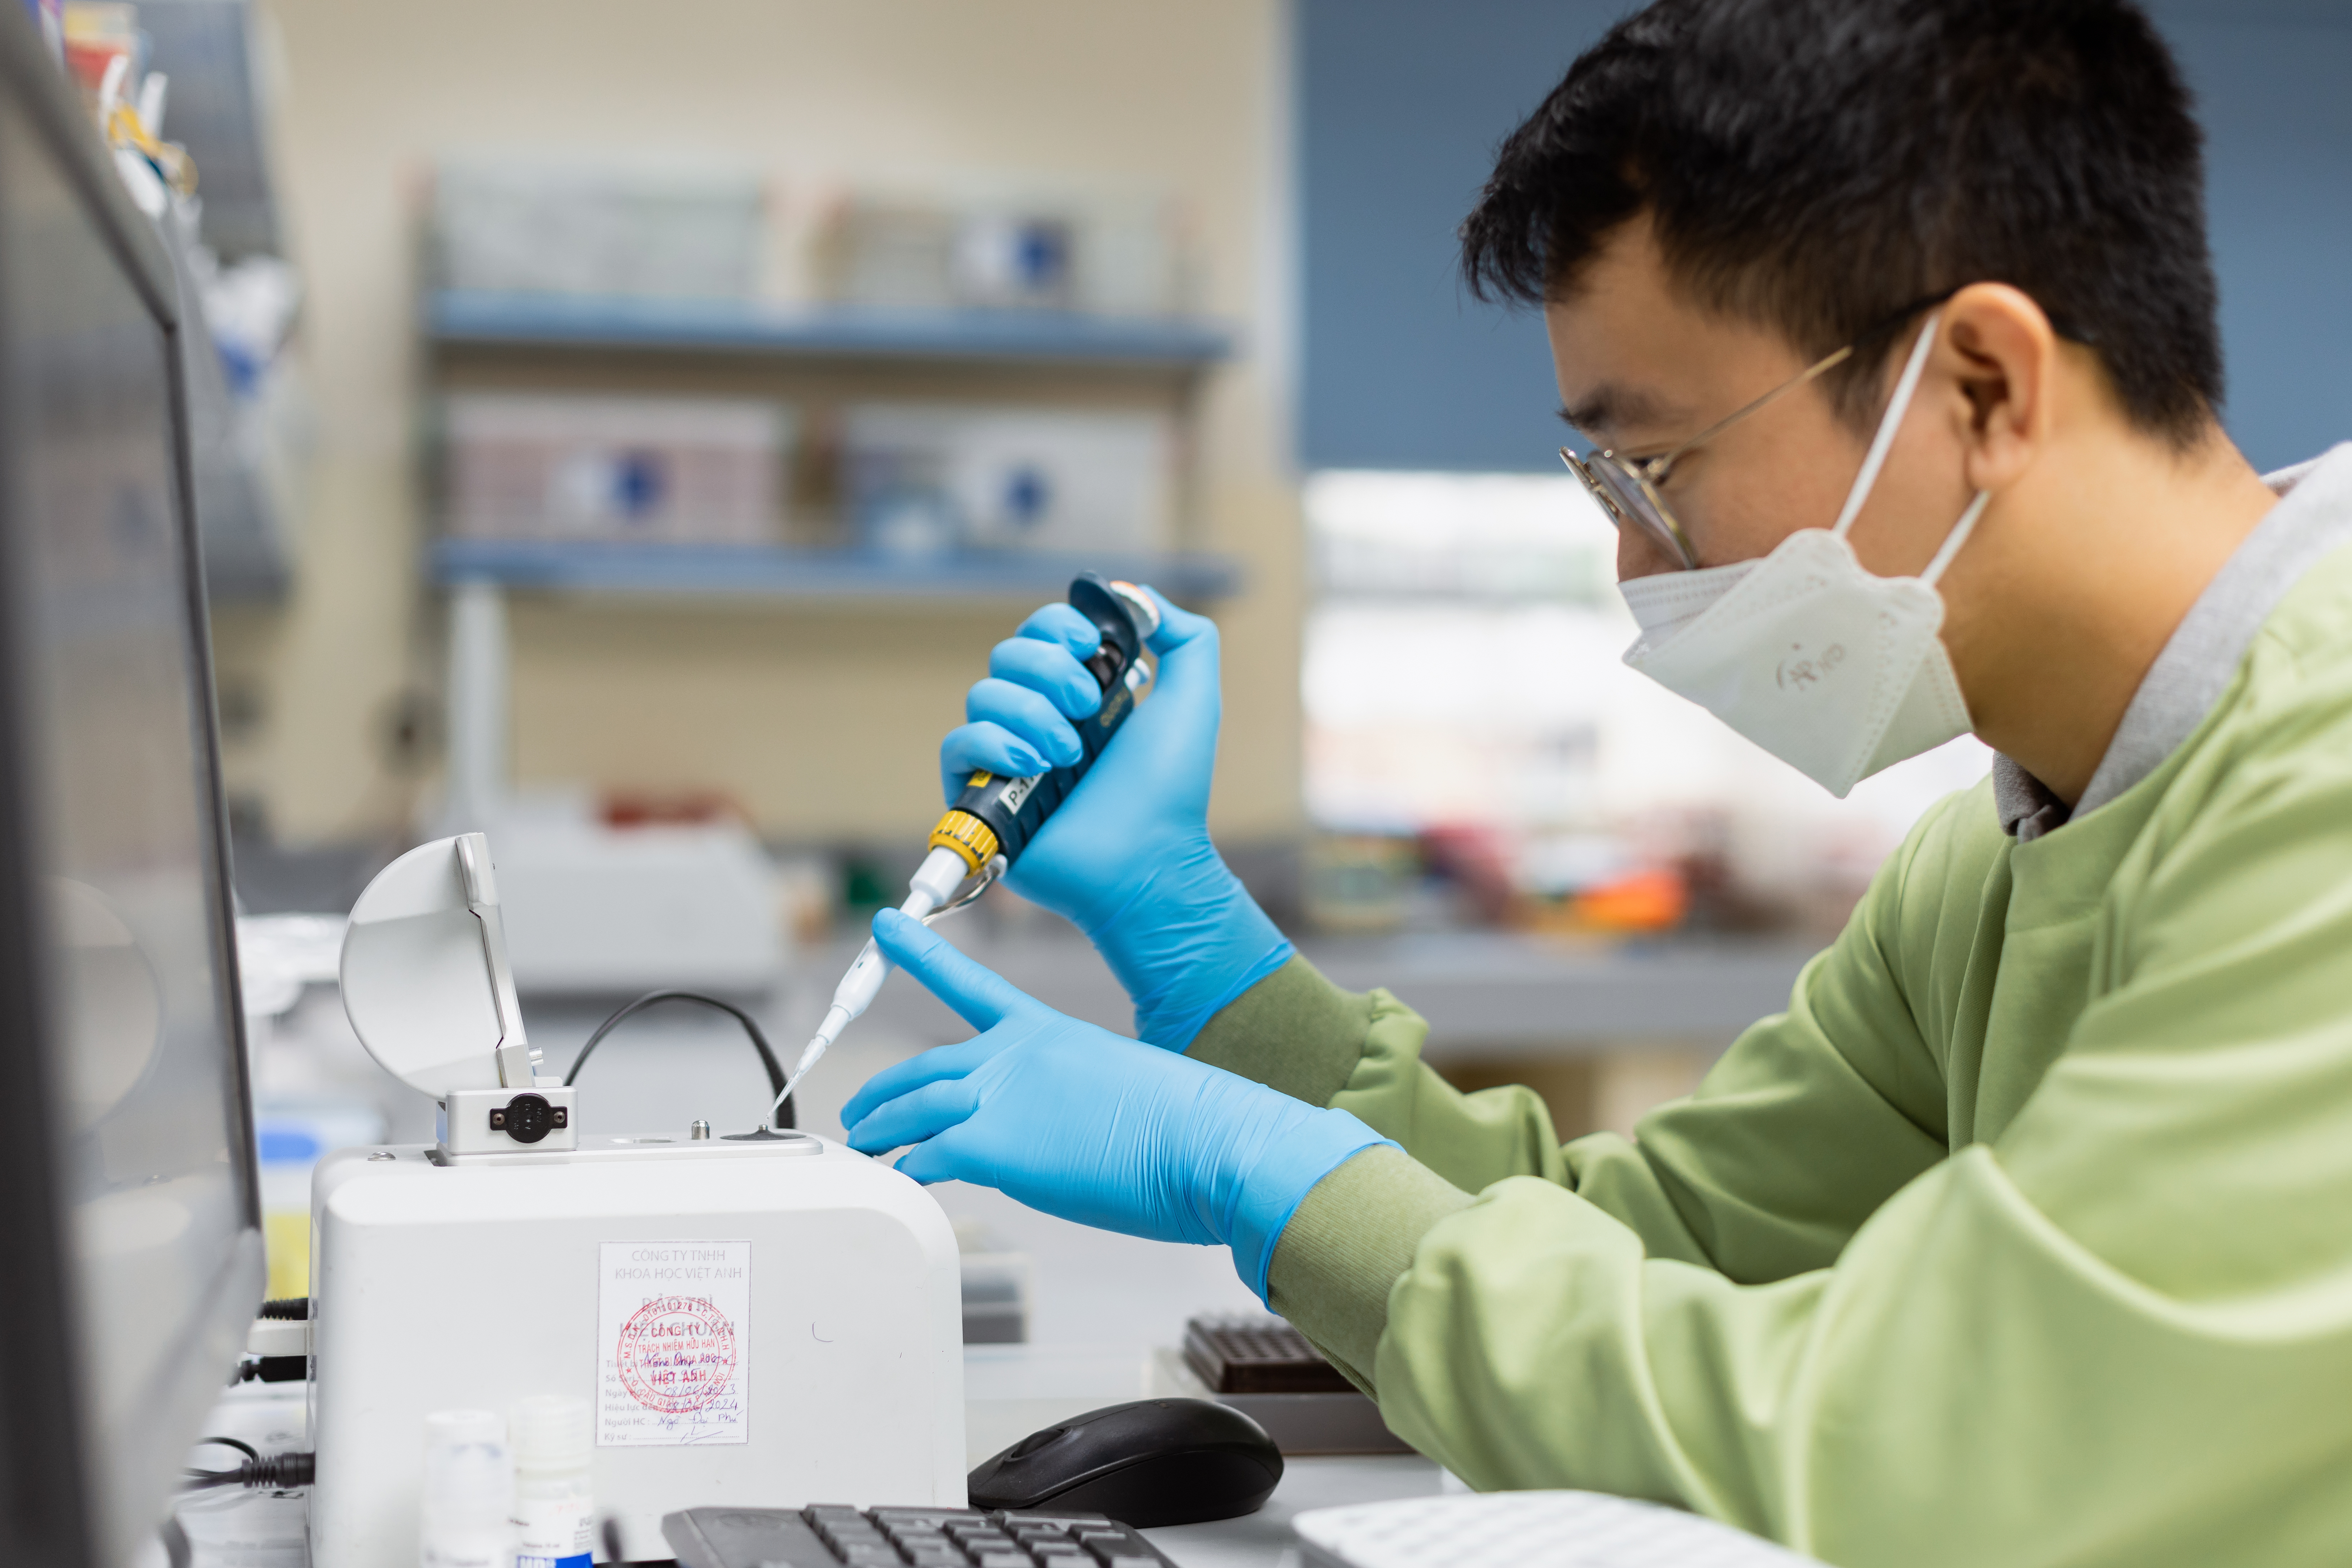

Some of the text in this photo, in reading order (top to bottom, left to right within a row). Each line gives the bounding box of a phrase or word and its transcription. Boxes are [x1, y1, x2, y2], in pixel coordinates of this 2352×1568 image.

[632, 1248, 725, 1261] CÔNG TY TNHH
[615, 1266, 742, 1281] KHOA HỌC VIỆT ANH
[651, 1323, 701, 1338] CÔNG TY
[638, 1341, 660, 1354] TRÁCH
[663, 1338, 684, 1353] NHIỆM
[702, 1339, 715, 1350] HẠN
[683, 1370, 707, 1383] ANH
